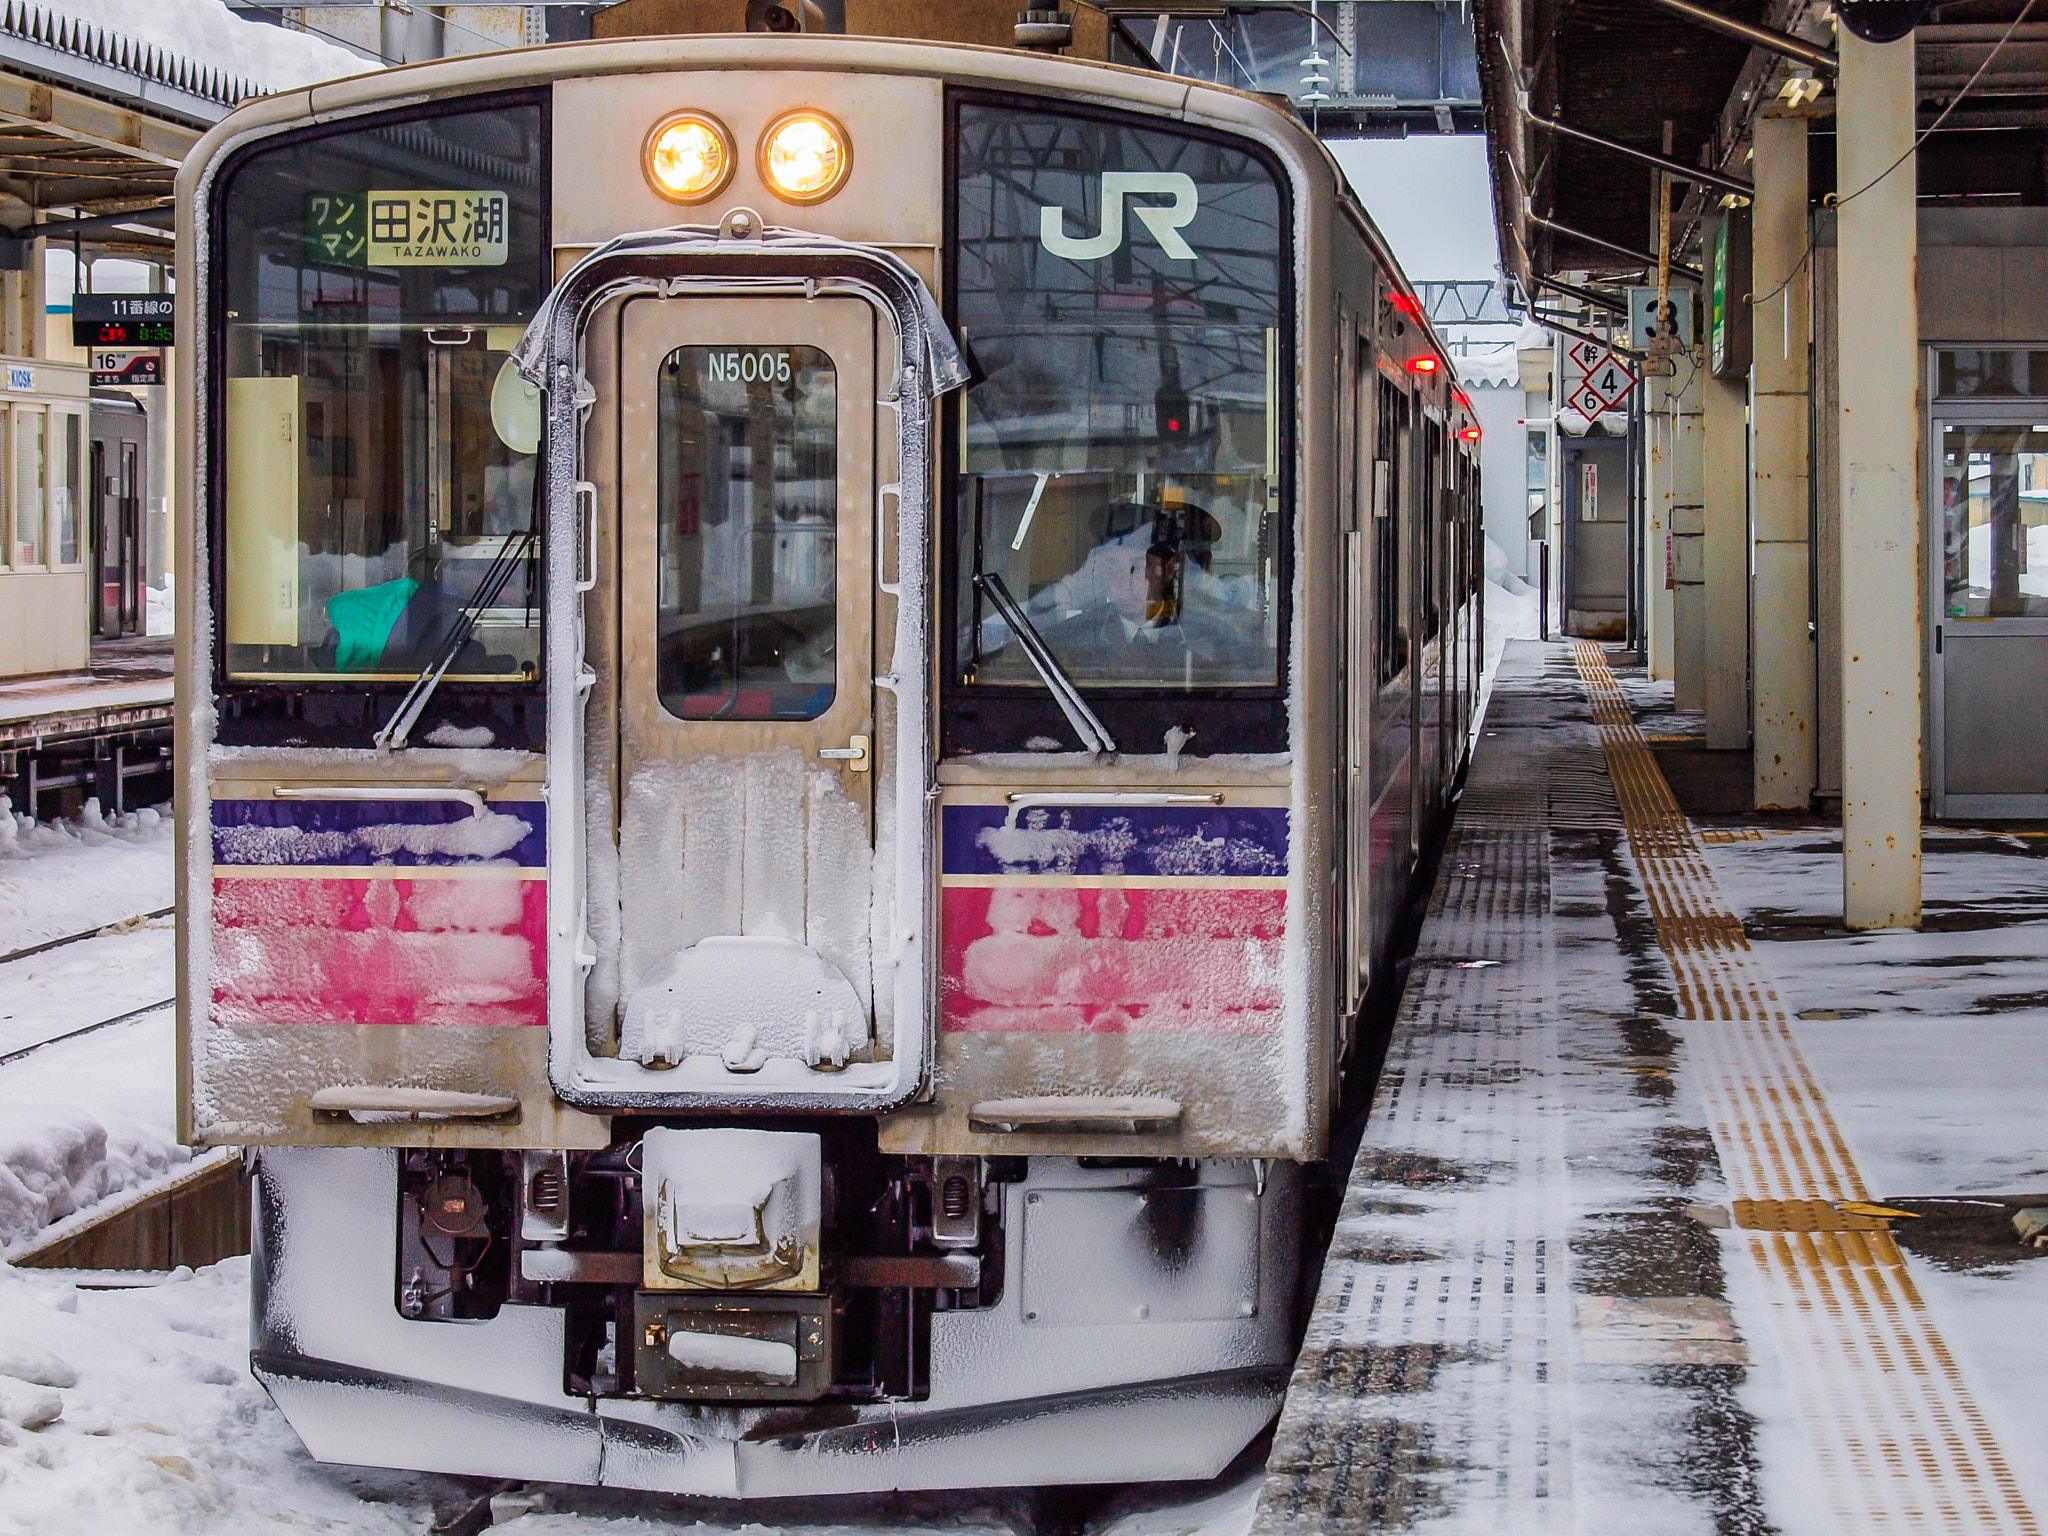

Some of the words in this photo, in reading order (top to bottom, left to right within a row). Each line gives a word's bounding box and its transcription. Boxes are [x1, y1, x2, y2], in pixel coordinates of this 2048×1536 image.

[312, 197, 355, 226] ワン
[371, 197, 504, 244] 田沢湖
[1041, 172, 1199, 260] JR
[322, 230, 365, 259] マン
[393, 246, 482, 257] TAZAWAKO
[112, 299, 173, 315] 11番線の
[139, 327, 173, 341] 8:35
[96, 353, 116, 370] 16
[1583, 344, 1599, 365] 幹
[708, 352, 791, 382] N5005
[11, 369, 32, 389] KIOSK
[96, 374, 120, 384] こまち
[1601, 368, 1618, 394] 4
[1584, 391, 1597, 410] 6
